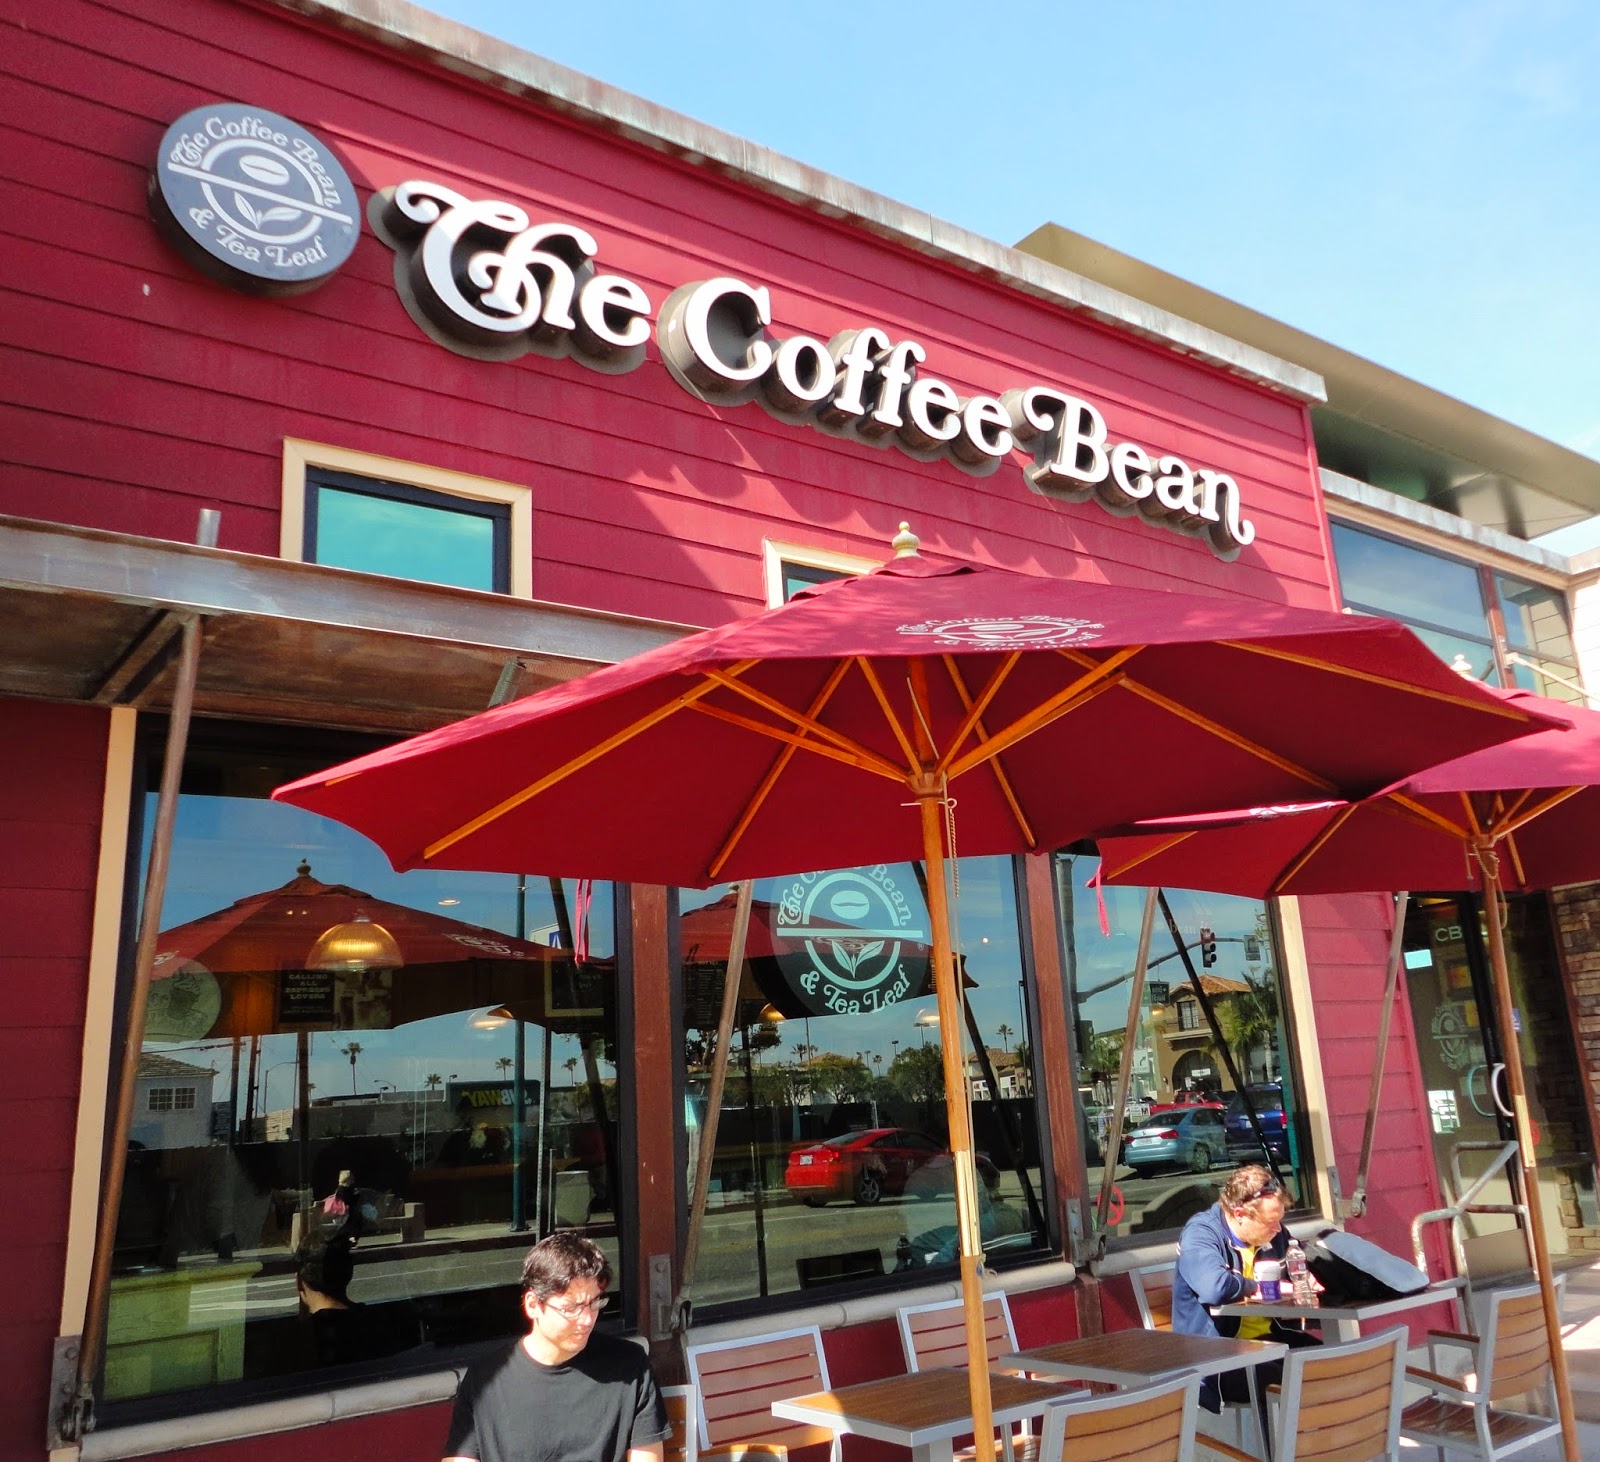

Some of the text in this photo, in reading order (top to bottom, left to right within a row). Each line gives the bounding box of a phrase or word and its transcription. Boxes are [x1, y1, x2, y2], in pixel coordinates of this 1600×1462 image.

[170, 116, 342, 209] The Coffee Bean
[188, 206, 328, 268] & Tea Leaf
[394, 179, 1256, 547] The Coffee Bean
[777, 864, 912, 927] The Bean
[800, 963, 911, 1015] & Tea Leaf
